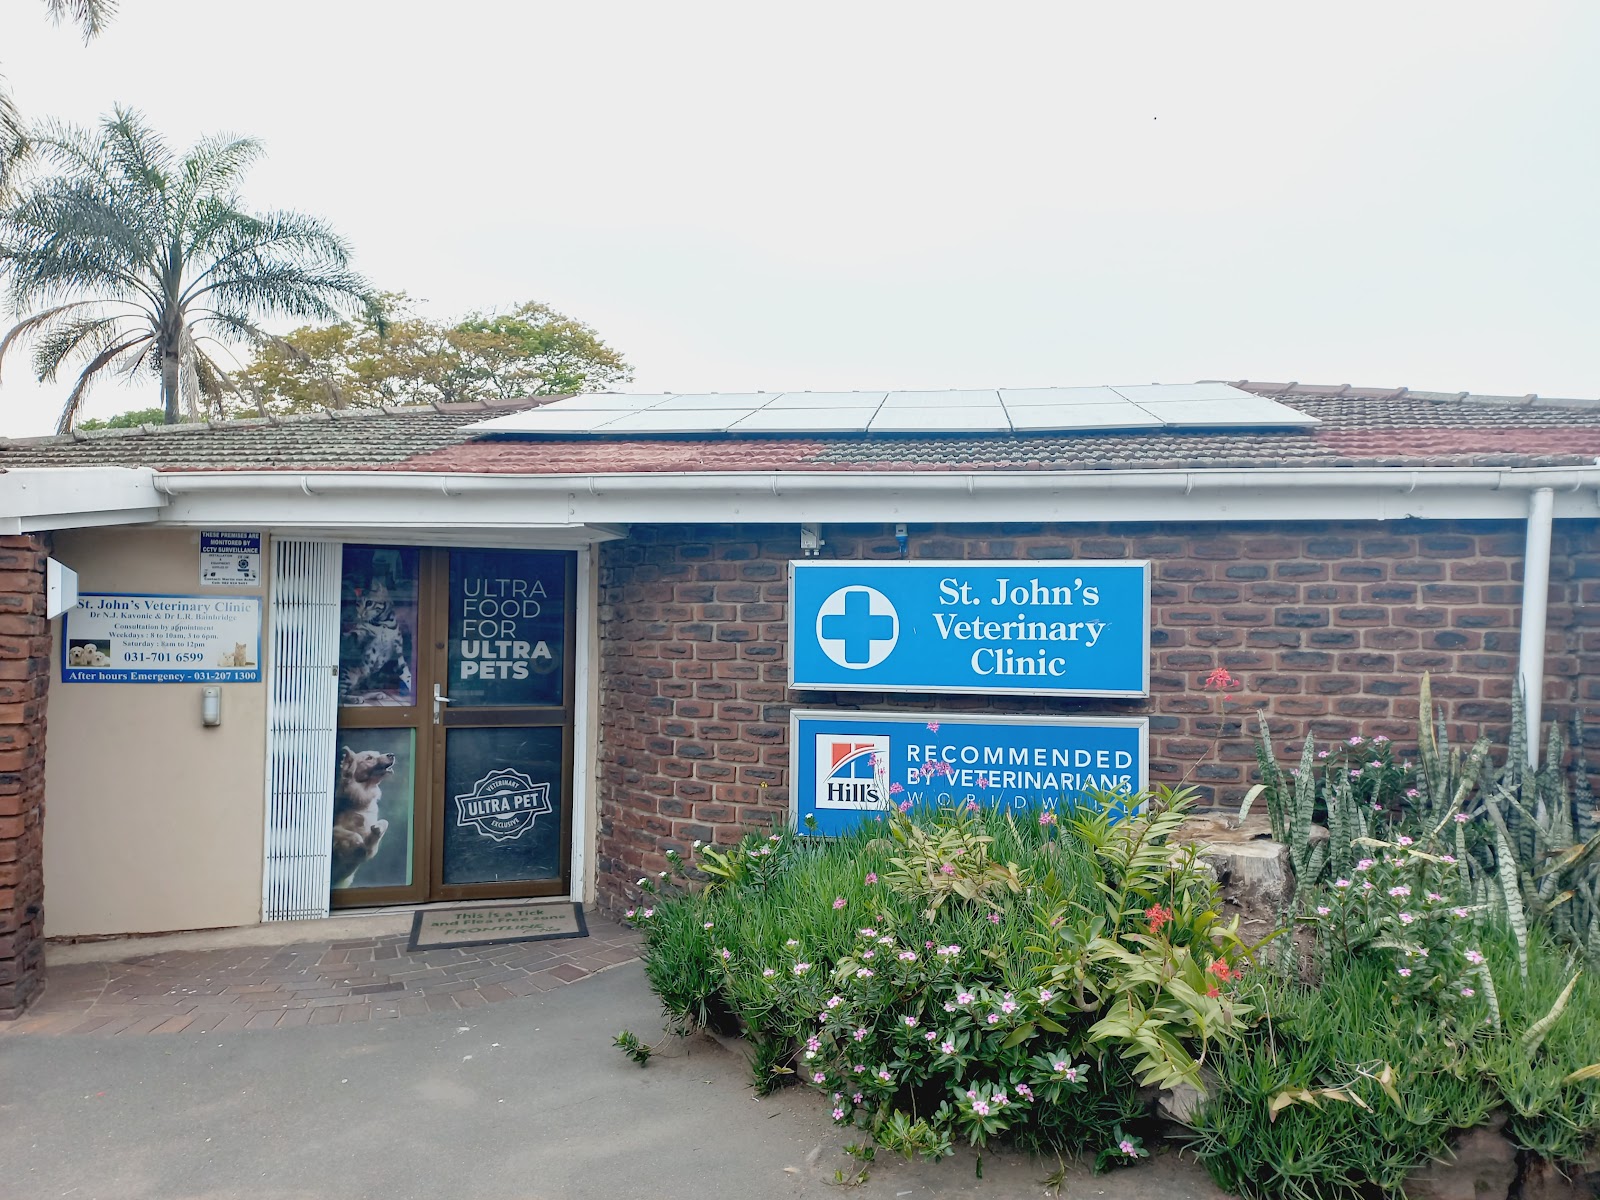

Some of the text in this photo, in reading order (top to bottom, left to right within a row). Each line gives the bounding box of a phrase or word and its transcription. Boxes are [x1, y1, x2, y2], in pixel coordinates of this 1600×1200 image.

[464, 578, 547, 598] ULTRA
[939, 578, 1100, 606] St. John's
[76, 598, 252, 614] St. John's Veterinary Clinic
[464, 599, 540, 618] FOOD
[463, 620, 516, 638] FOR
[932, 613, 1106, 647] Veterinary
[124, 652, 204, 662] 031-701 6599
[461, 640, 552, 659] ULTRA
[460, 661, 529, 679] PETS
[971, 648, 1066, 676] Clinic
[69, 672, 96, 680] After
[99, 672, 127, 680] hours
[130, 672, 184, 683] Emergency
[234, 672, 256, 680] 1300
[907, 744, 1132, 769] RECOMMENDED
[486, 780, 520, 792] VETERINARY
[907, 767, 1132, 793] BY VETERINARIANS
[828, 782, 879, 802] Hill's
[468, 793, 538, 816] ULTRA PET
[491, 818, 520, 828] EXCLUSIVE
[444, 924, 544, 935] FRONTLINE
